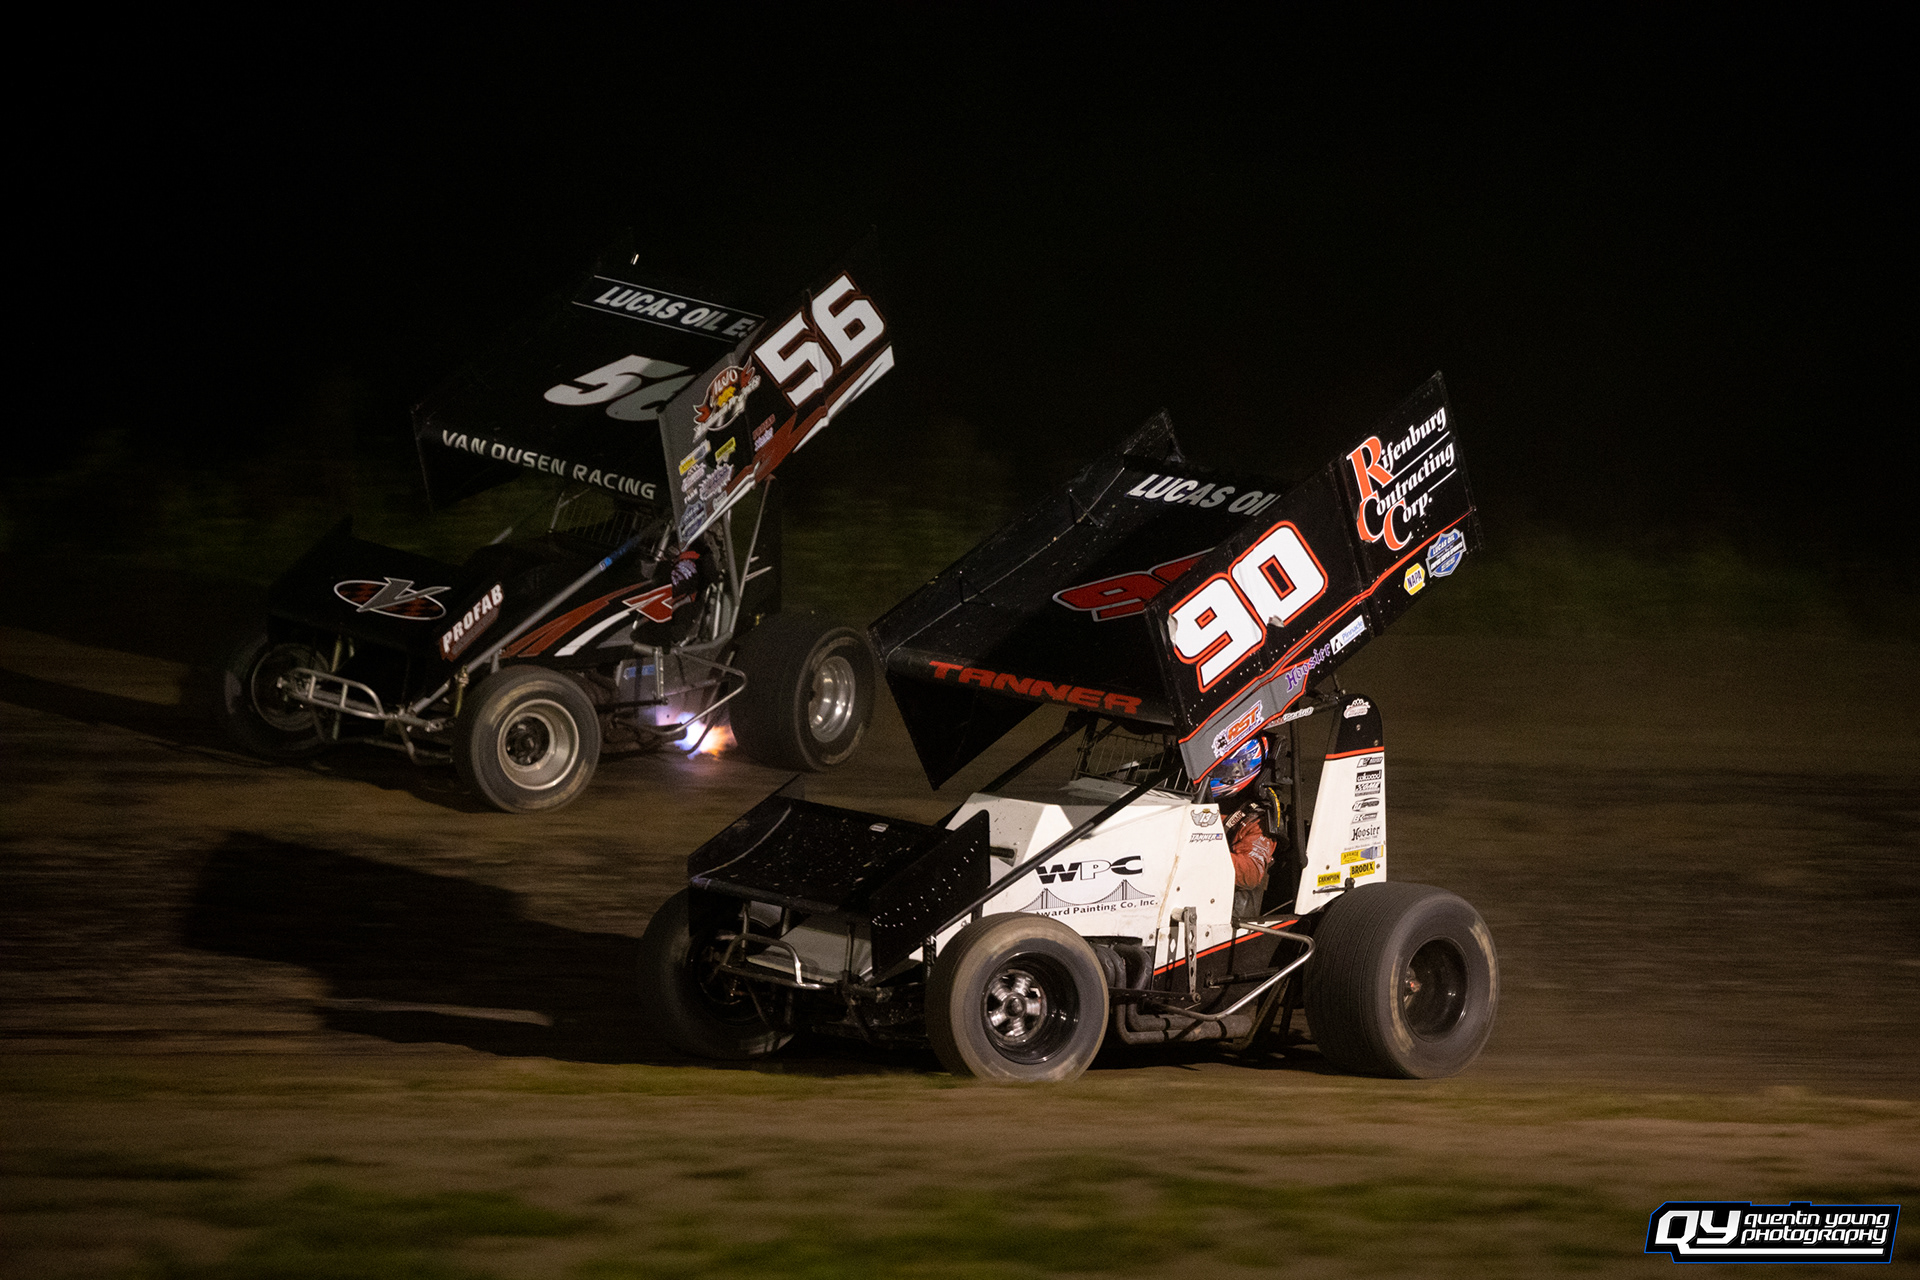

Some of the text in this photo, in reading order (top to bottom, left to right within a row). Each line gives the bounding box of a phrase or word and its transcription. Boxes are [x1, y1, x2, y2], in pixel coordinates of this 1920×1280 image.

[593, 285, 679, 320] LUCAS
[681, 304, 728, 332] OIL
[753, 272, 885, 406] 56
[441, 429, 487, 456] VAN
[572, 463, 657, 500] RACING
[1346, 406, 1447, 501] Rifenburg
[1125, 473, 1235, 508] LUCAS
[1356, 442, 1455, 543] Contracting
[1383, 493, 1433, 551] Corp.
[1406, 569, 1423, 589] NAPA
[441, 583, 504, 654] PROFAB
[1168, 521, 1328, 692] 90
[1341, 619, 1364, 641] Pinnacle
[929, 660, 1143, 715] TANNER
[1285, 643, 1331, 693] Hoosier
[1227, 706, 1260, 742] RST
[1199, 813, 1211, 823] 13
[1352, 825, 1381, 841] Hoosier
[1035, 855, 1143, 885] WPC
[1351, 861, 1374, 875] BRODIX
[1073, 904, 1117, 914] Painting
[1140, 899, 1159, 907] Inc.
